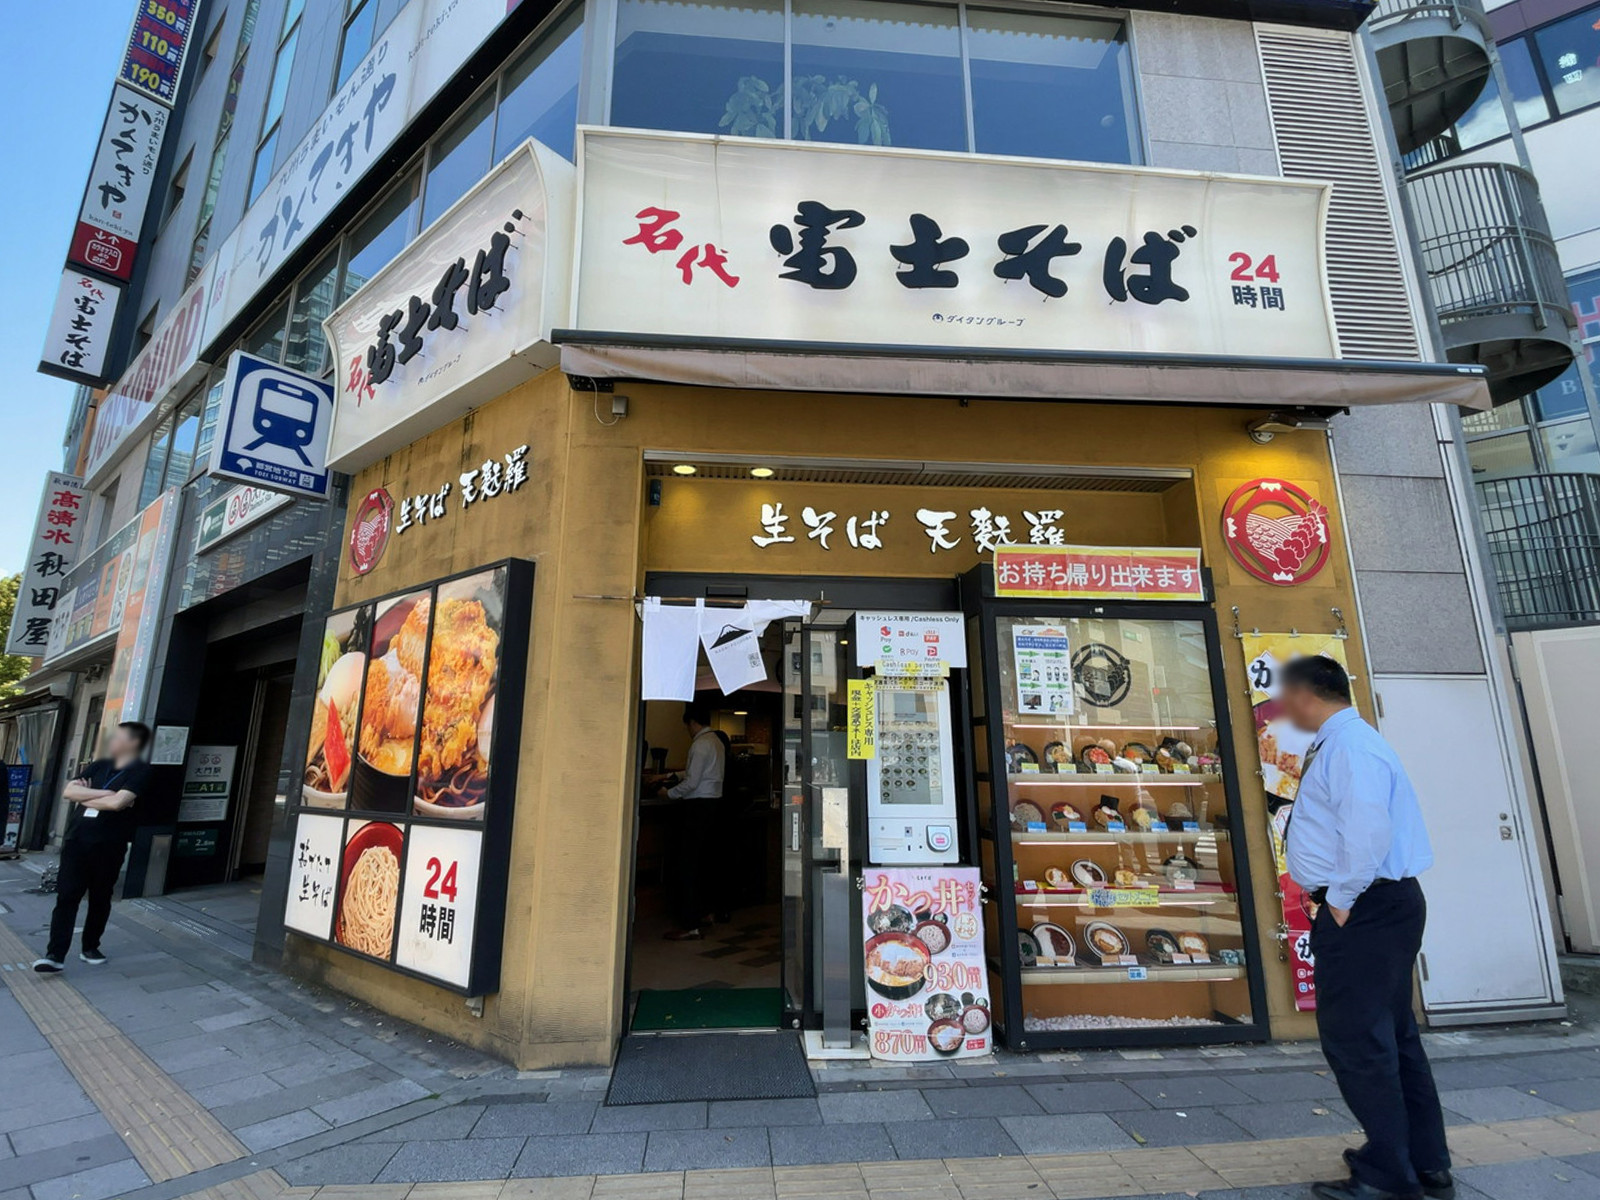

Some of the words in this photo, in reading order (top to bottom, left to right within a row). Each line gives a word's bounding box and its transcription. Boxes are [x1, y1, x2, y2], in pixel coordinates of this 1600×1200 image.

[623, 206, 740, 288] 名代
[769, 200, 1198, 305] 富士そば
[1228, 251, 1281, 284] 24
[77, 277, 105, 300] 名代
[345, 354, 376, 407] 名代
[367, 209, 524, 386] 富士そば
[1231, 285, 1286, 311] 時間
[60, 295, 100, 369] 富士そば
[946, 314, 1025, 327] ダイタングループ
[396, 482, 450, 534] 生そば
[751, 502, 890, 550] 生そば
[998, 561, 1201, 588] お持ち帰り出来ます
[15, 551, 69, 647] 秋田屋
[944, 616, 960, 624] Only
[423, 856, 458, 903] 24
[867, 875, 965, 916] かつ丼
[419, 903, 456, 945] 時間
[923, 961, 982, 993] 930円
[874, 1029, 927, 1055] 870円
